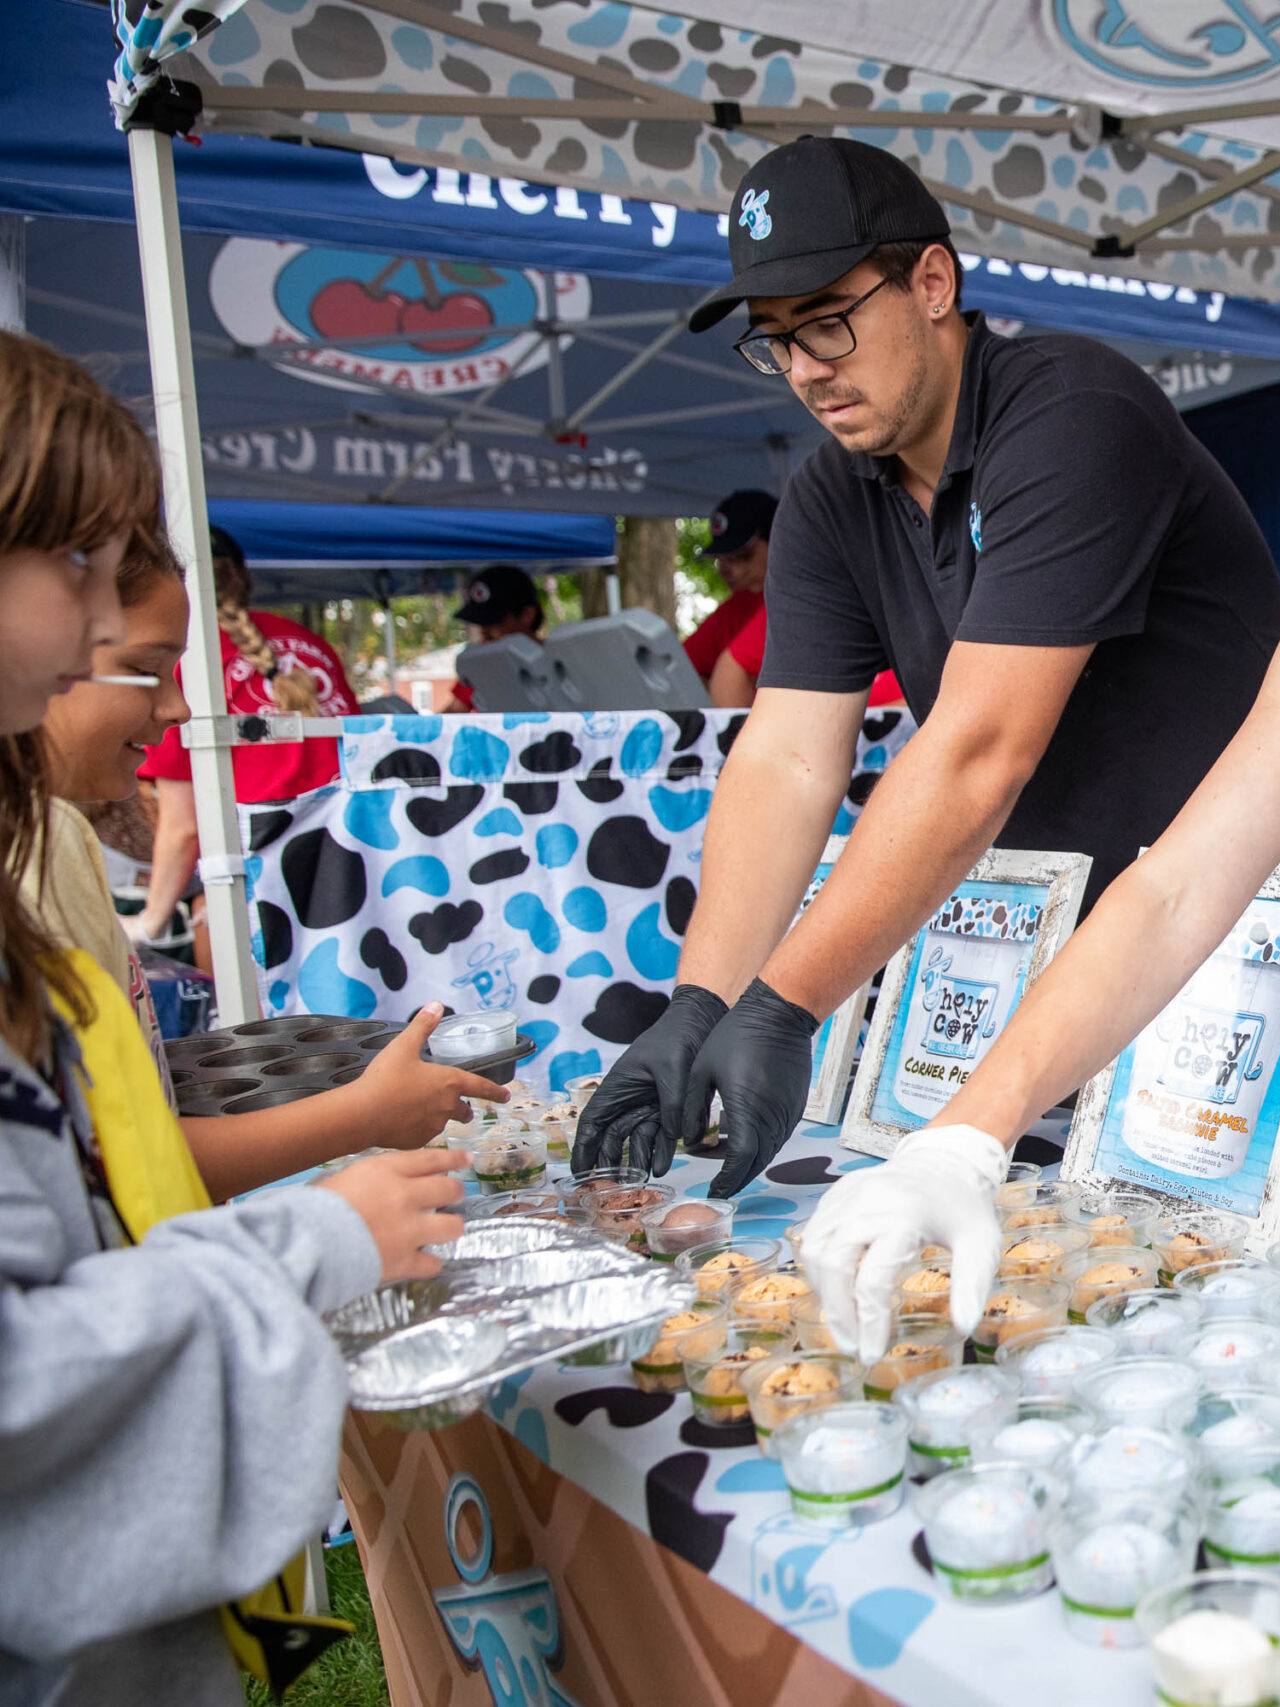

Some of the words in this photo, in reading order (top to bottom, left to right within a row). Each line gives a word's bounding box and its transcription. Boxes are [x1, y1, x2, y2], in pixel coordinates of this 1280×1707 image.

[939, 987, 989, 1023] holy
[904, 1056, 946, 1081] CORNER
[1185, 1102, 1249, 1133] CARAMEL
[1117, 1164, 1149, 1181] Contains:
[1190, 1186, 1213, 1200] Gluten
[1220, 1195, 1233, 1207] Soy
